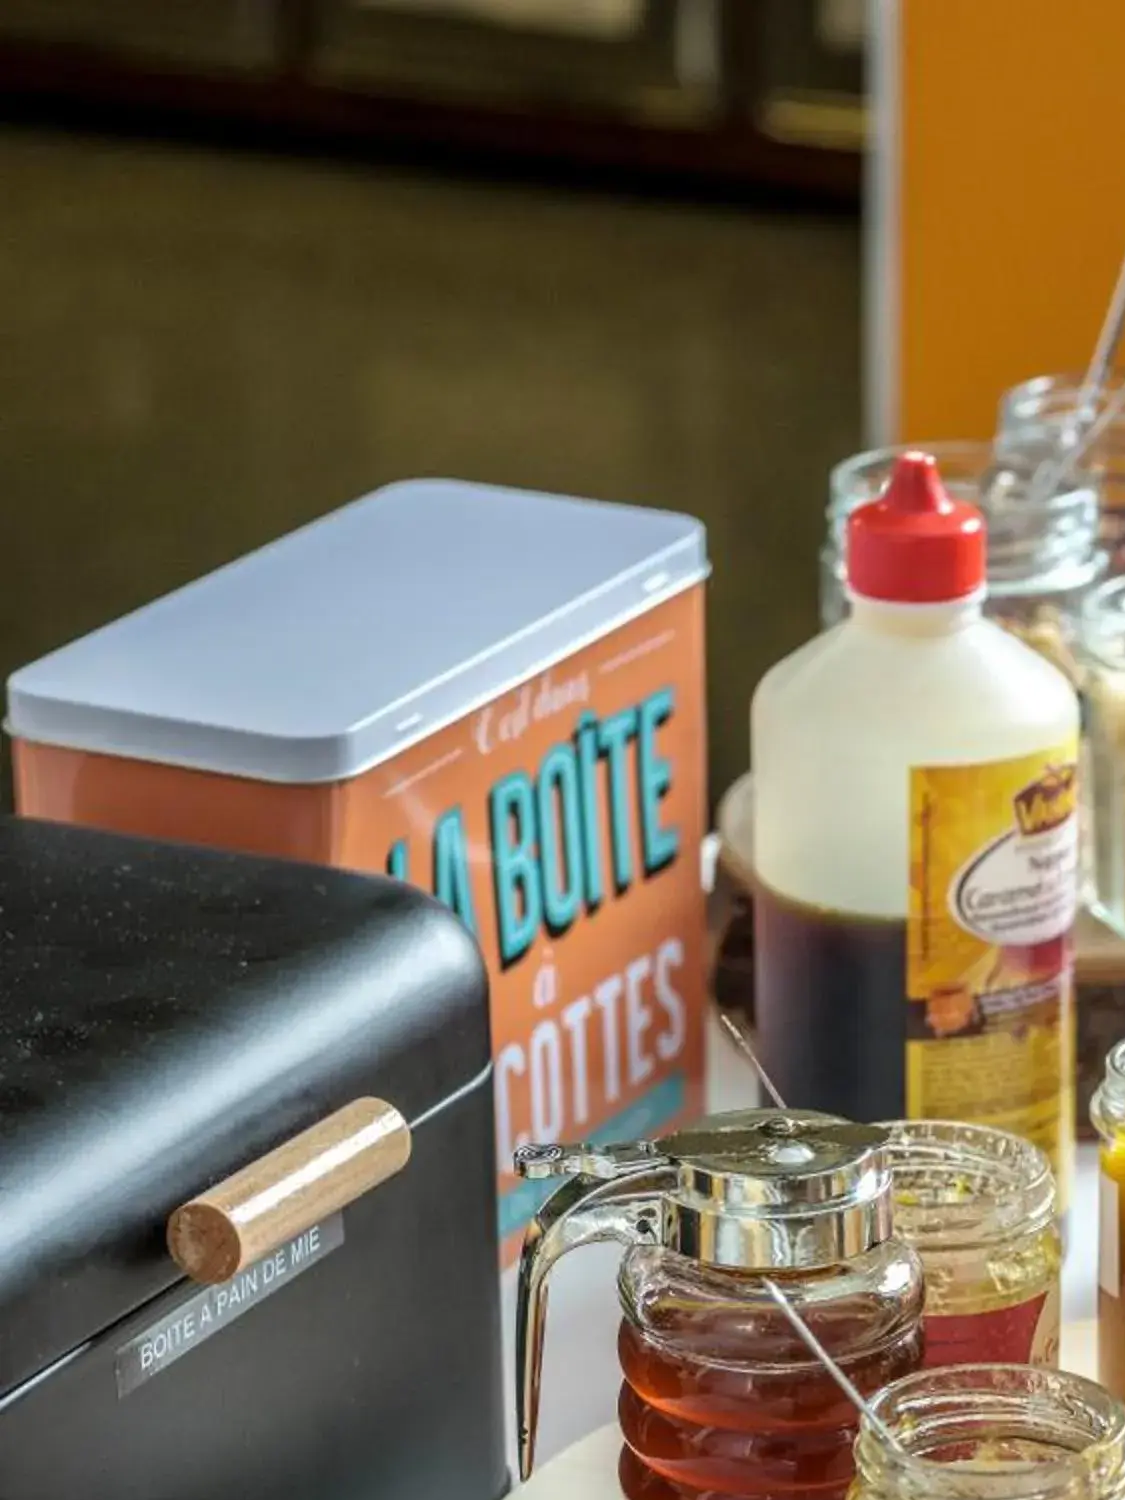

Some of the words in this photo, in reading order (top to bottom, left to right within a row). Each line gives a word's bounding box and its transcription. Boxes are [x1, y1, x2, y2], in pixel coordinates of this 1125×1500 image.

[386, 802, 477, 936] A
[487, 684, 679, 973] BOÎTE
[140, 1312, 197, 1371] BOITE
[200, 1303, 214, 1325] A
[216, 1268, 259, 1317] PAIN
[262, 1249, 287, 1285] DE
[290, 1225, 322, 1267] MIE
